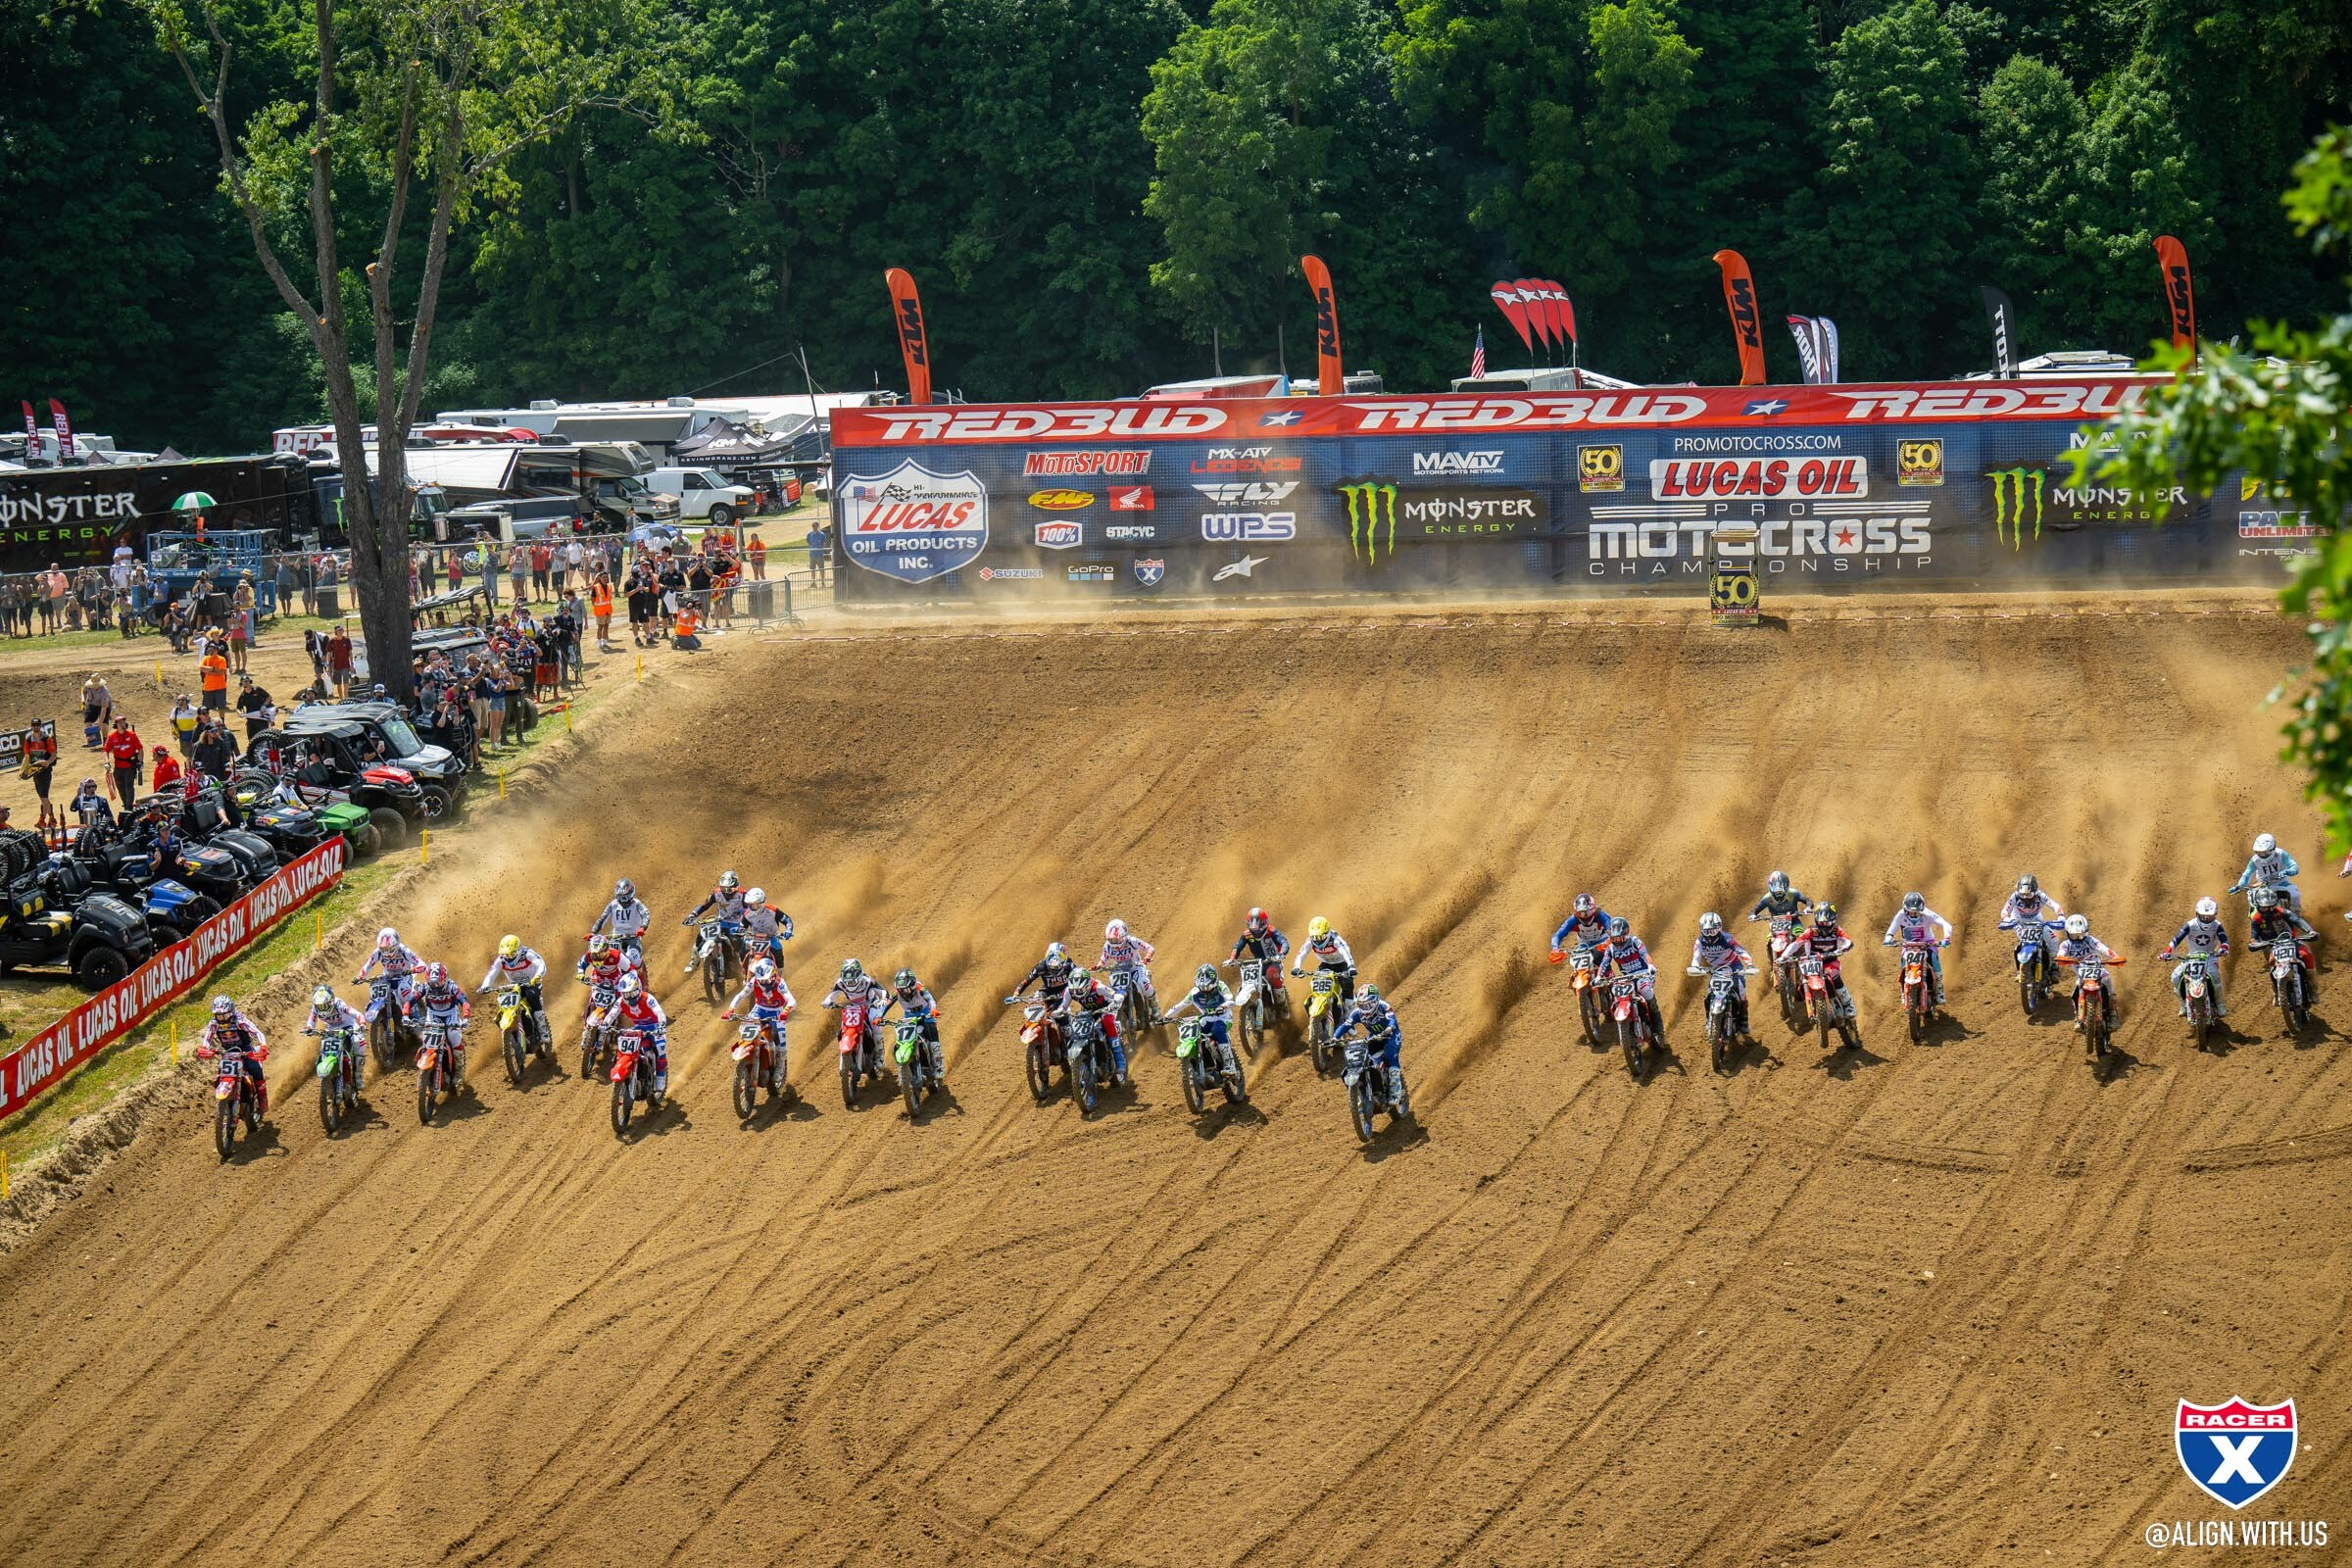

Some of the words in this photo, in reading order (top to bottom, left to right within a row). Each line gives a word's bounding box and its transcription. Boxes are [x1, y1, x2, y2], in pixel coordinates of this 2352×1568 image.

[2169, 267, 2191, 337] KTM
[1731, 278, 1758, 348] KTM
[1318, 287, 1338, 358] KTM
[900, 299, 926, 366] KTM
[26, 416, 38, 438] RED
[55, 414, 71, 435] RED
[1675, 435, 1840, 452] PROMOTOCROSS.COM
[1208, 448, 1235, 459] MX
[1241, 447, 1273, 459] ATV
[1414, 451, 1504, 469] MAVTV
[1905, 444, 1937, 468] 50
[1191, 458, 1302, 474] LEGENDS
[1586, 449, 1618, 474] 50
[1660, 459, 1789, 496] LUCAS
[1795, 459, 1860, 494] OIL
[1192, 481, 1301, 501] FLY
[1029, 492, 1094, 505] FMF
[0, 492, 142, 525] ONSTER
[1404, 498, 1537, 521] MONSTER
[1716, 503, 1805, 516] PRO
[858, 501, 975, 531] LUCAS
[1105, 526, 1155, 538] STACYC
[1202, 513, 1297, 540] WPS
[1425, 523, 1515, 533] ENERGY
[1042, 528, 1076, 542] 100%
[852, 541, 880, 554] OIL
[885, 536, 978, 551] PRODUCTS
[899, 557, 934, 569] INC.
[1067, 564, 1114, 573] GoPro
[1590, 557, 1933, 575] CHAMPIONSHIP
[994, 568, 1044, 579] SUZUKI
[1143, 568, 1157, 581] X
[1716, 575, 1755, 605] 50
[2262, 863, 2278, 875] FLY
[615, 909, 632, 921] FLY
[702, 925, 717, 938] 12
[752, 942, 767, 953] 57
[1572, 956, 1591, 969] 73
[1801, 961, 1822, 974] 140
[2185, 962, 2206, 976] 437
[1112, 973, 1129, 987] 26
[1243, 968, 1258, 981] 63
[2080, 968, 2102, 980] 129
[371, 985, 388, 999] 35
[1313, 981, 1331, 992] 285
[1712, 980, 1731, 992] 97
[17, 1045, 54, 1098] LUCAS
[57, 1033, 74, 1071] OIL
[78, 999, 117, 1052] LUCAS
[120, 984, 138, 1023] OIL
[140, 956, 173, 1008] LUCAS
[173, 942, 196, 984] OIL
[196, 917, 227, 965] LUCAS
[228, 906, 246, 943] OIL
[250, 890, 277, 931] LUCAS
[500, 995, 517, 1006] 41
[594, 992, 613, 1004] 93
[845, 1012, 860, 1026] 23
[1028, 1006, 1044, 1021] 7
[742, 1026, 757, 1039] 5
[897, 1027, 914, 1041] 17
[1181, 1025, 1199, 1039] 21
[322, 1040, 340, 1053] 65
[620, 1039, 636, 1053] 94
[1351, 1049, 1364, 1063] 3
[221, 1061, 238, 1075] 51
